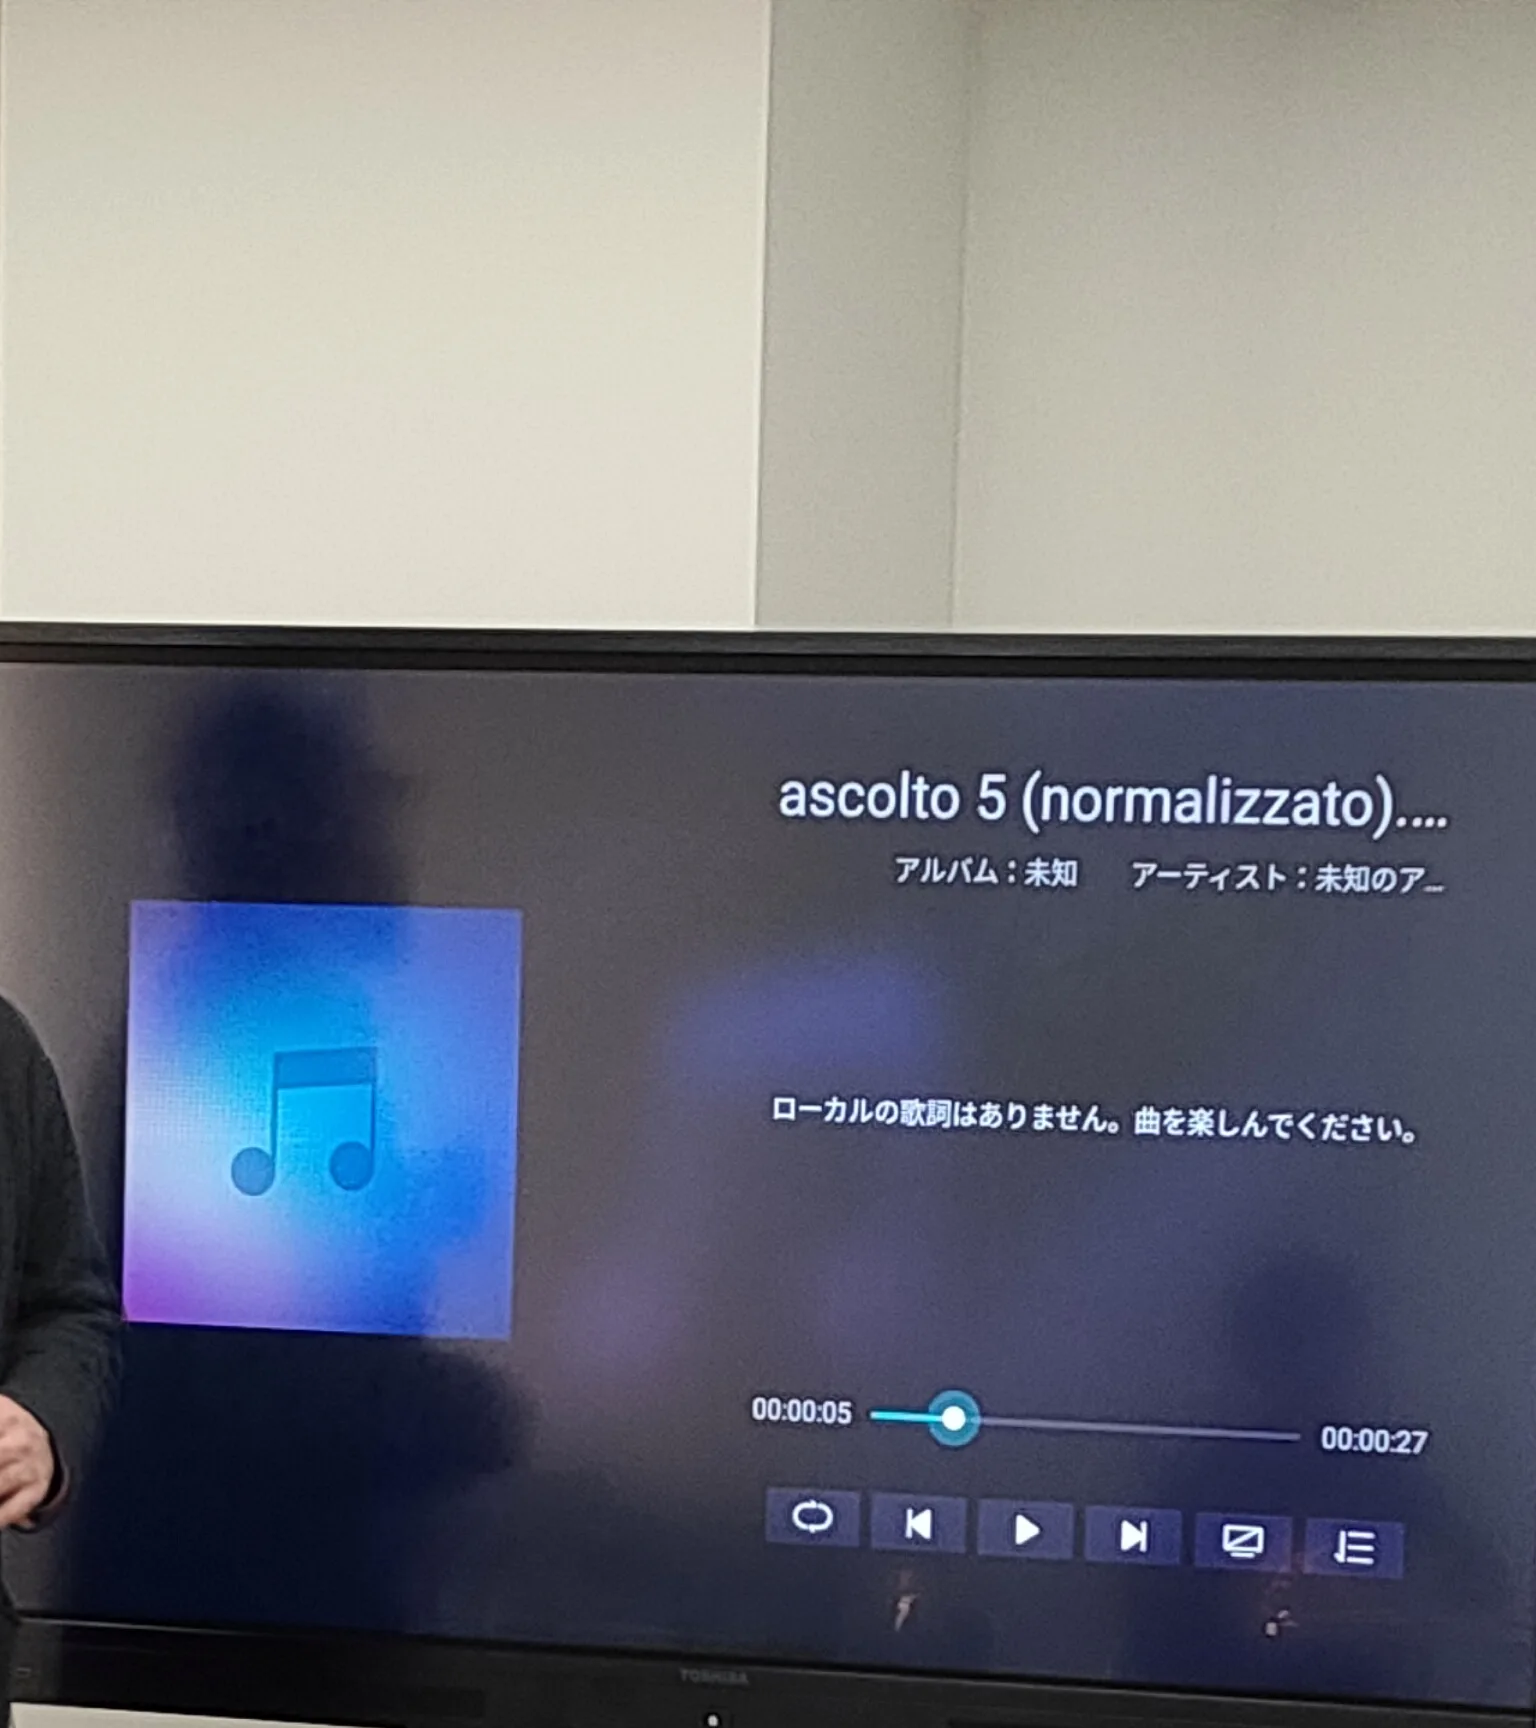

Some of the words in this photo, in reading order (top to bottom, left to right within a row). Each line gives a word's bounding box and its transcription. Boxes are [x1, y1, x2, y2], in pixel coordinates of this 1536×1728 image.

[779, 770, 961, 820] ascolto
[977, 773, 1007, 821] 5
[895, 856, 1078, 888] アルバム：未知
[752, 1397, 852, 1424] 00:00:05
[1322, 1425, 1429, 1455] 00:00:27
